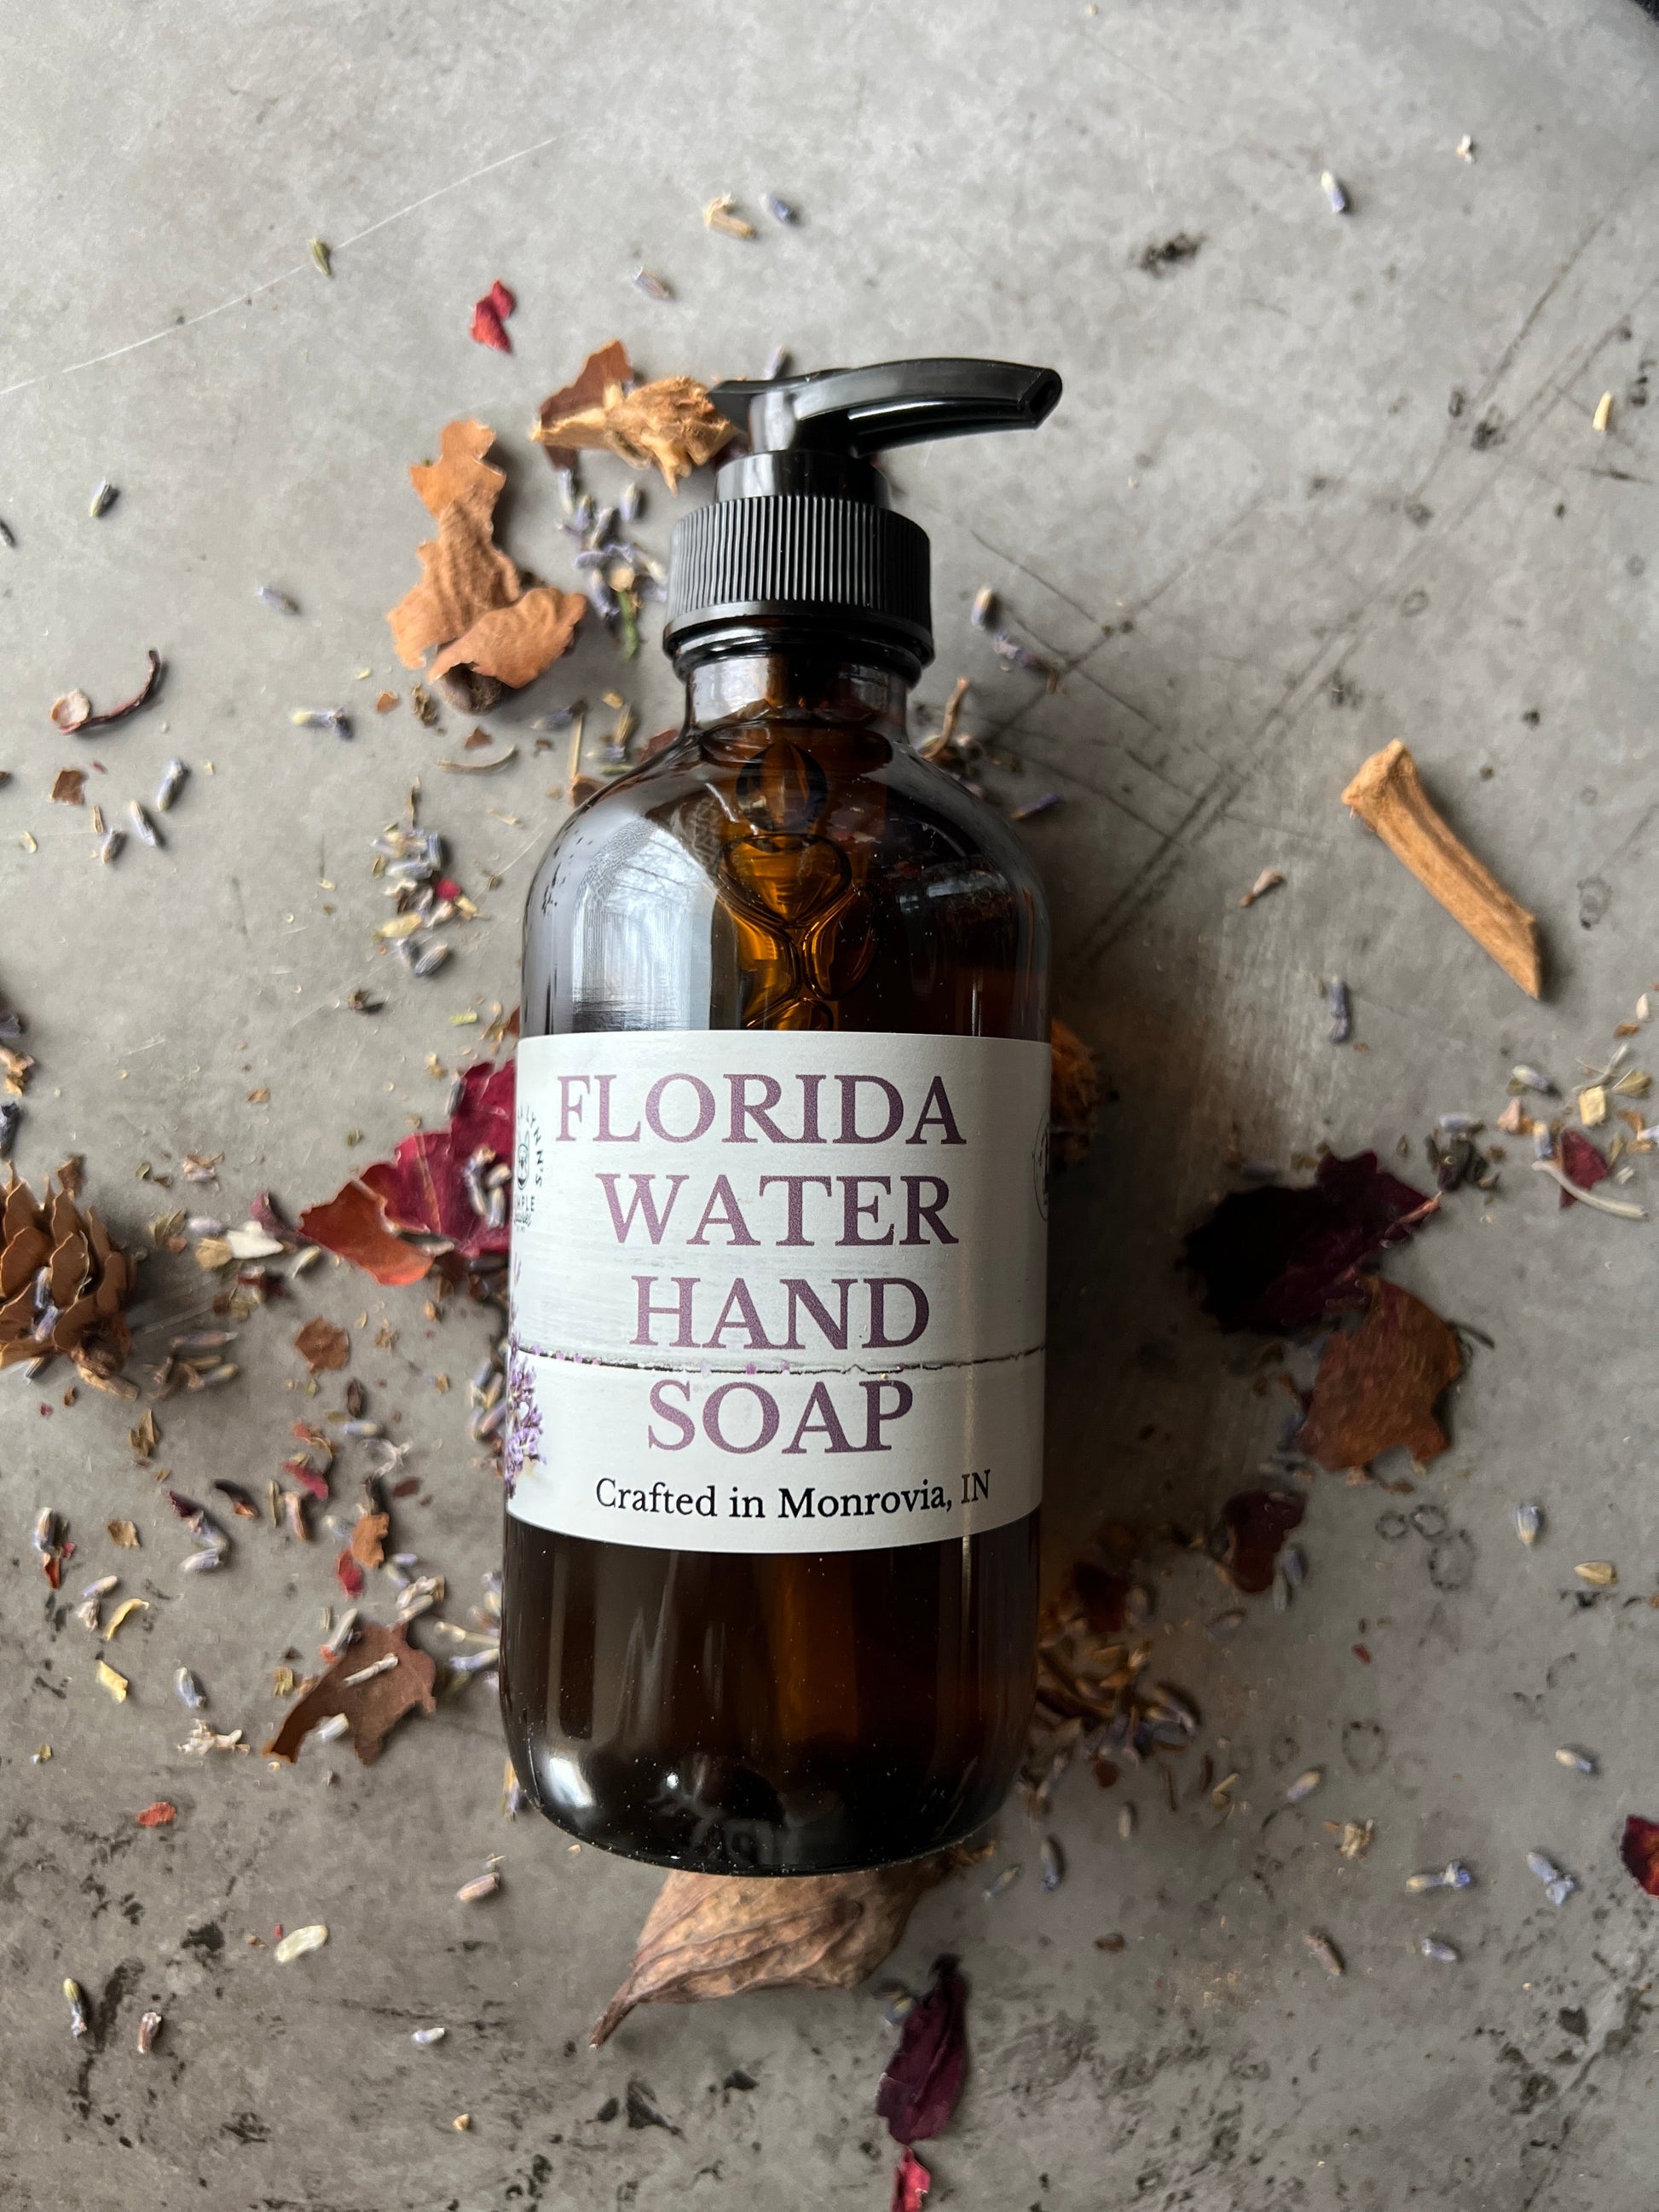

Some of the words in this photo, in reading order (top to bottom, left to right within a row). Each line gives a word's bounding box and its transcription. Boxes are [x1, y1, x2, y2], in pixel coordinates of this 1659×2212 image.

[556, 1073, 966, 1144] FLORIDA
[595, 1174, 958, 1246] WATER
[630, 1276, 929, 1350] HAND
[648, 1379, 912, 1454] SOAP
[597, 1478, 718, 1517] Crafted
[729, 1487, 766, 1518] in
[777, 1479, 953, 1519] Monrovia,
[961, 1470, 991, 1505] IN
